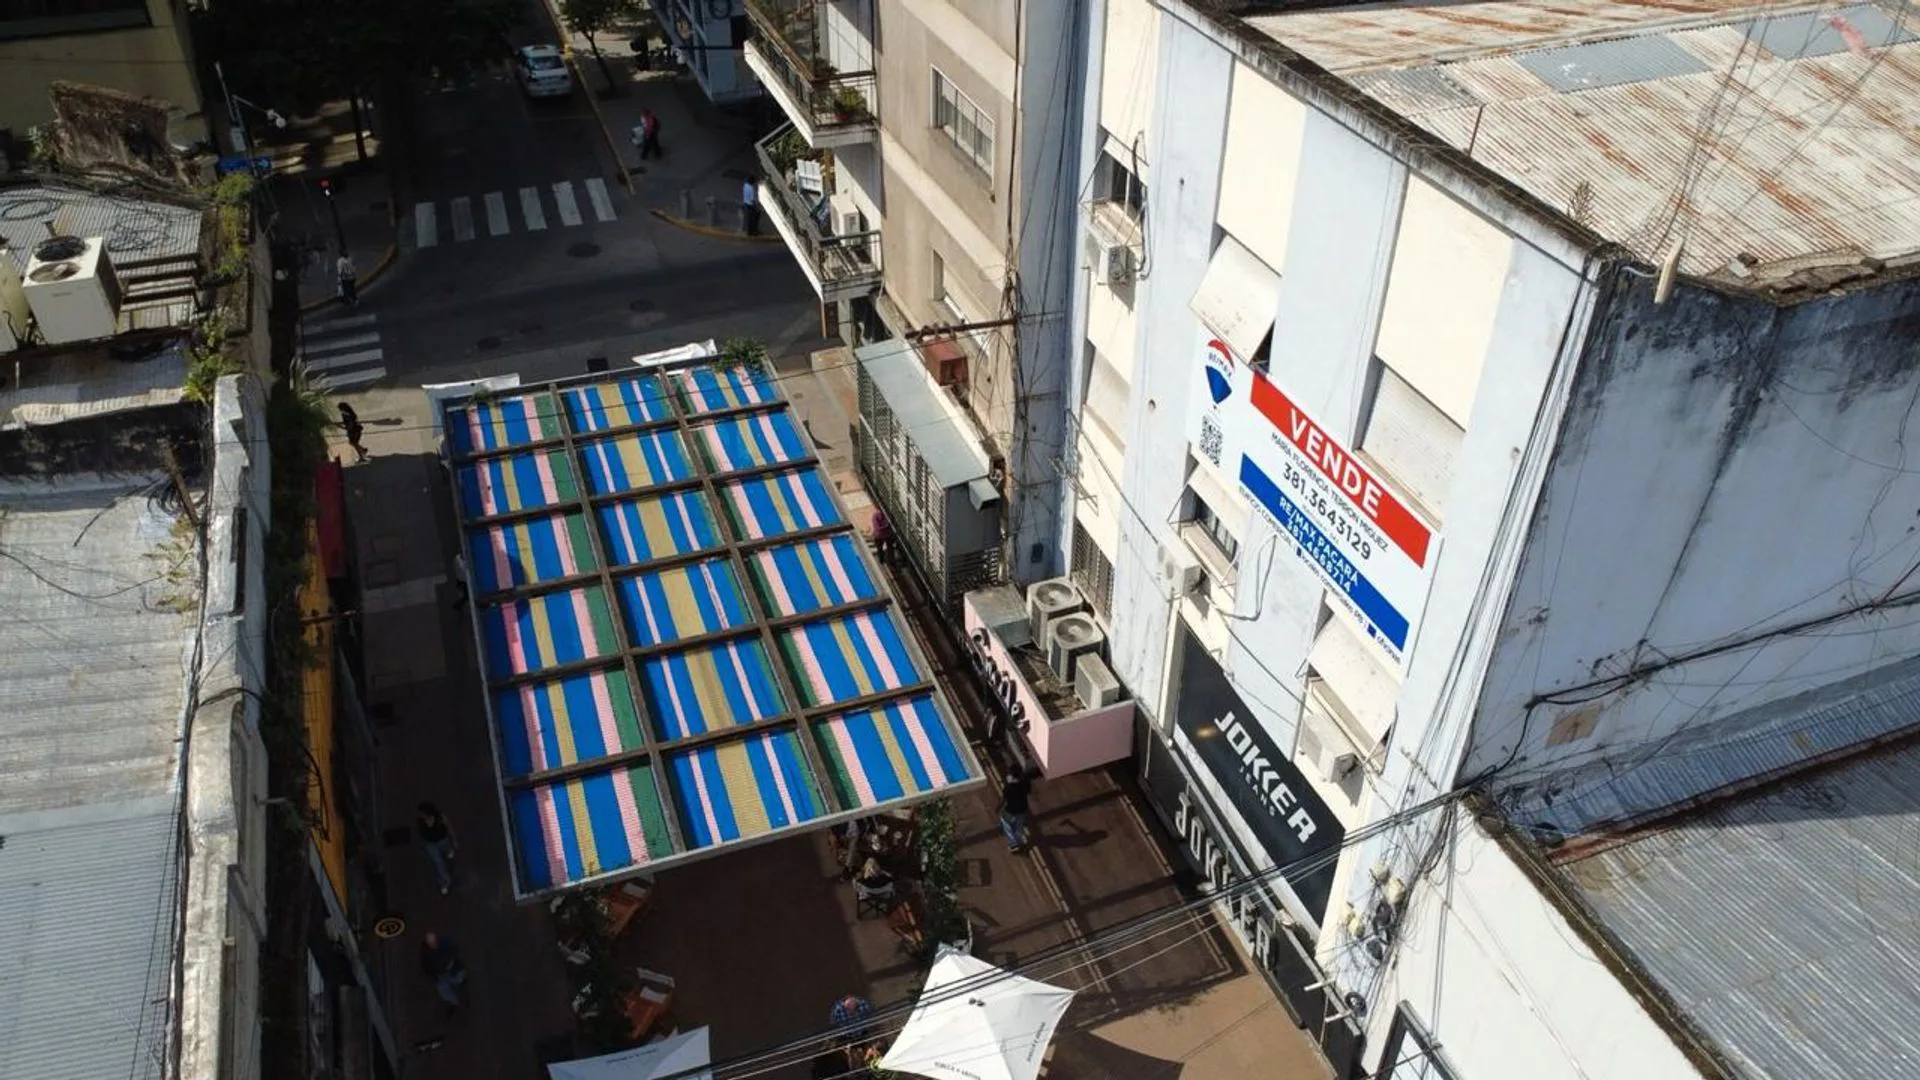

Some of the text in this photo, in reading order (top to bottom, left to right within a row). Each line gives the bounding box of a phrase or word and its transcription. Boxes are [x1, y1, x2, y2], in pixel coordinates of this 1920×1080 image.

[1290, 408, 1382, 519] VENDE
[1293, 452, 1329, 494] FLORENCIA
[1279, 497, 1317, 542] RE/MAX
[1282, 462, 1371, 559] 381.3643129
